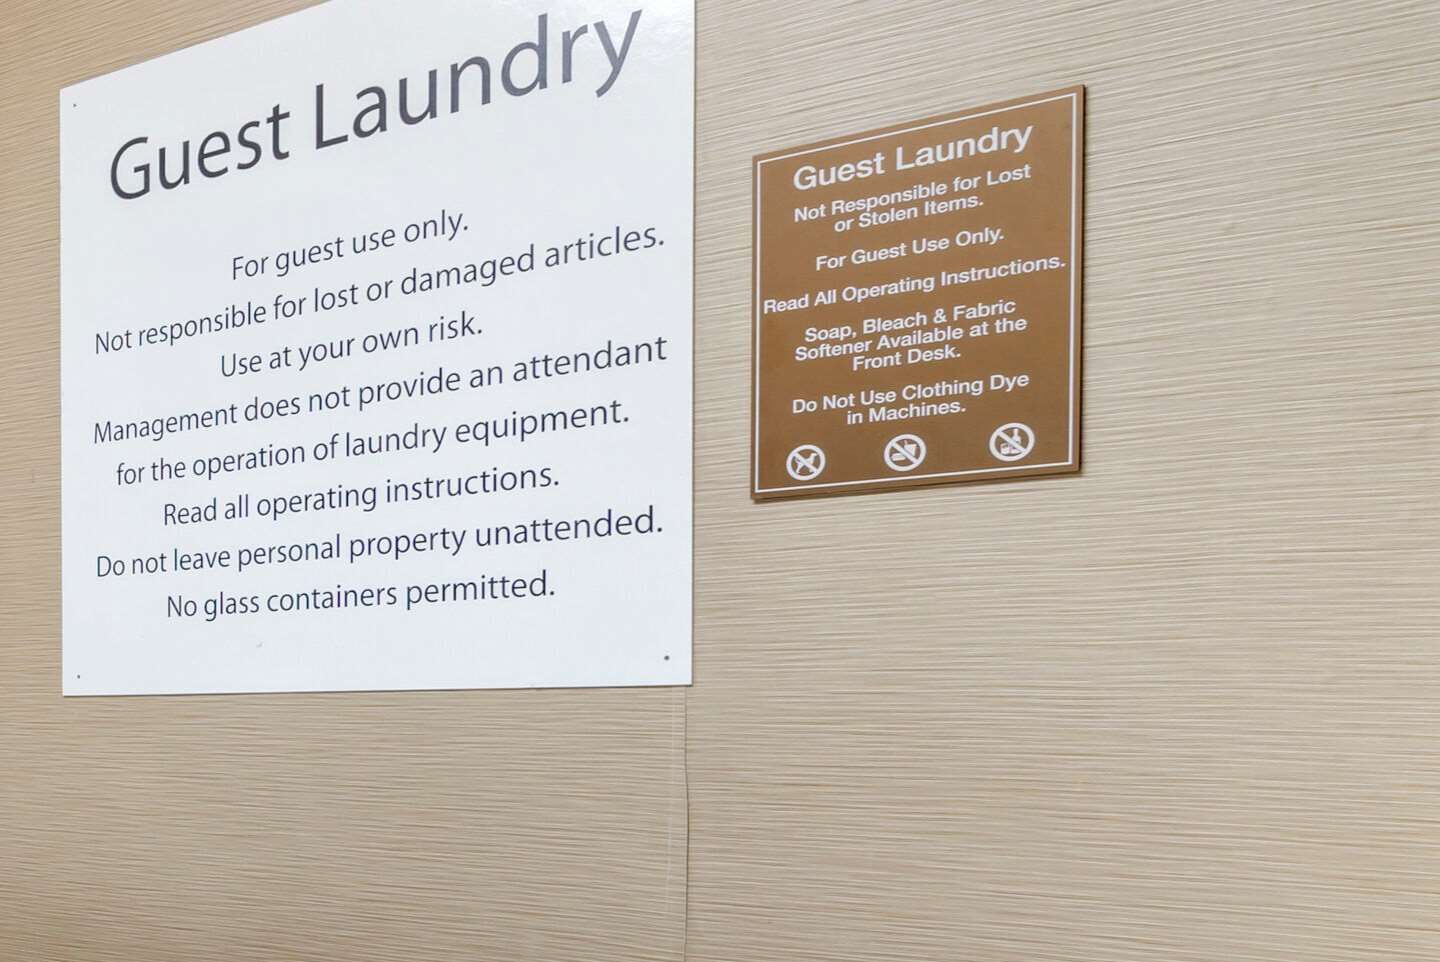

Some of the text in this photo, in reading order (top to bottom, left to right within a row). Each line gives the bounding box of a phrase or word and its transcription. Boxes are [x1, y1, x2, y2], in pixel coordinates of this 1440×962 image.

[110, 8, 642, 199] Guest Laundry
[793, 126, 1033, 190] Guest Laundry
[795, 163, 1031, 222] Not Responsible for Lost
[834, 194, 984, 232] or Stolen Items.
[233, 209, 468, 280] For guest use only.
[816, 227, 1005, 270] For Guest Use Only.
[96, 226, 664, 354] Not responsible for lost or damaged articles.
[763, 256, 1066, 314] Read All Operating Instructions.
[221, 311, 483, 377] Use at your own risk.
[795, 318, 1028, 361] Softener Available at the
[805, 300, 1016, 343] Soap, Bleach & Fabric
[852, 344, 961, 371] Front Desk.
[94, 336, 668, 444] Management does not provide an attendant
[792, 373, 1030, 414] Do Not Use Clothing Dye
[847, 401, 966, 425] in Machines.
[117, 400, 629, 485] for the operation of laundry equipment.
[164, 467, 559, 525] Read all operating instructions.
[97, 505, 663, 577] Do not leave personal property unattended.
[167, 569, 555, 622] No glass containers permitted.
